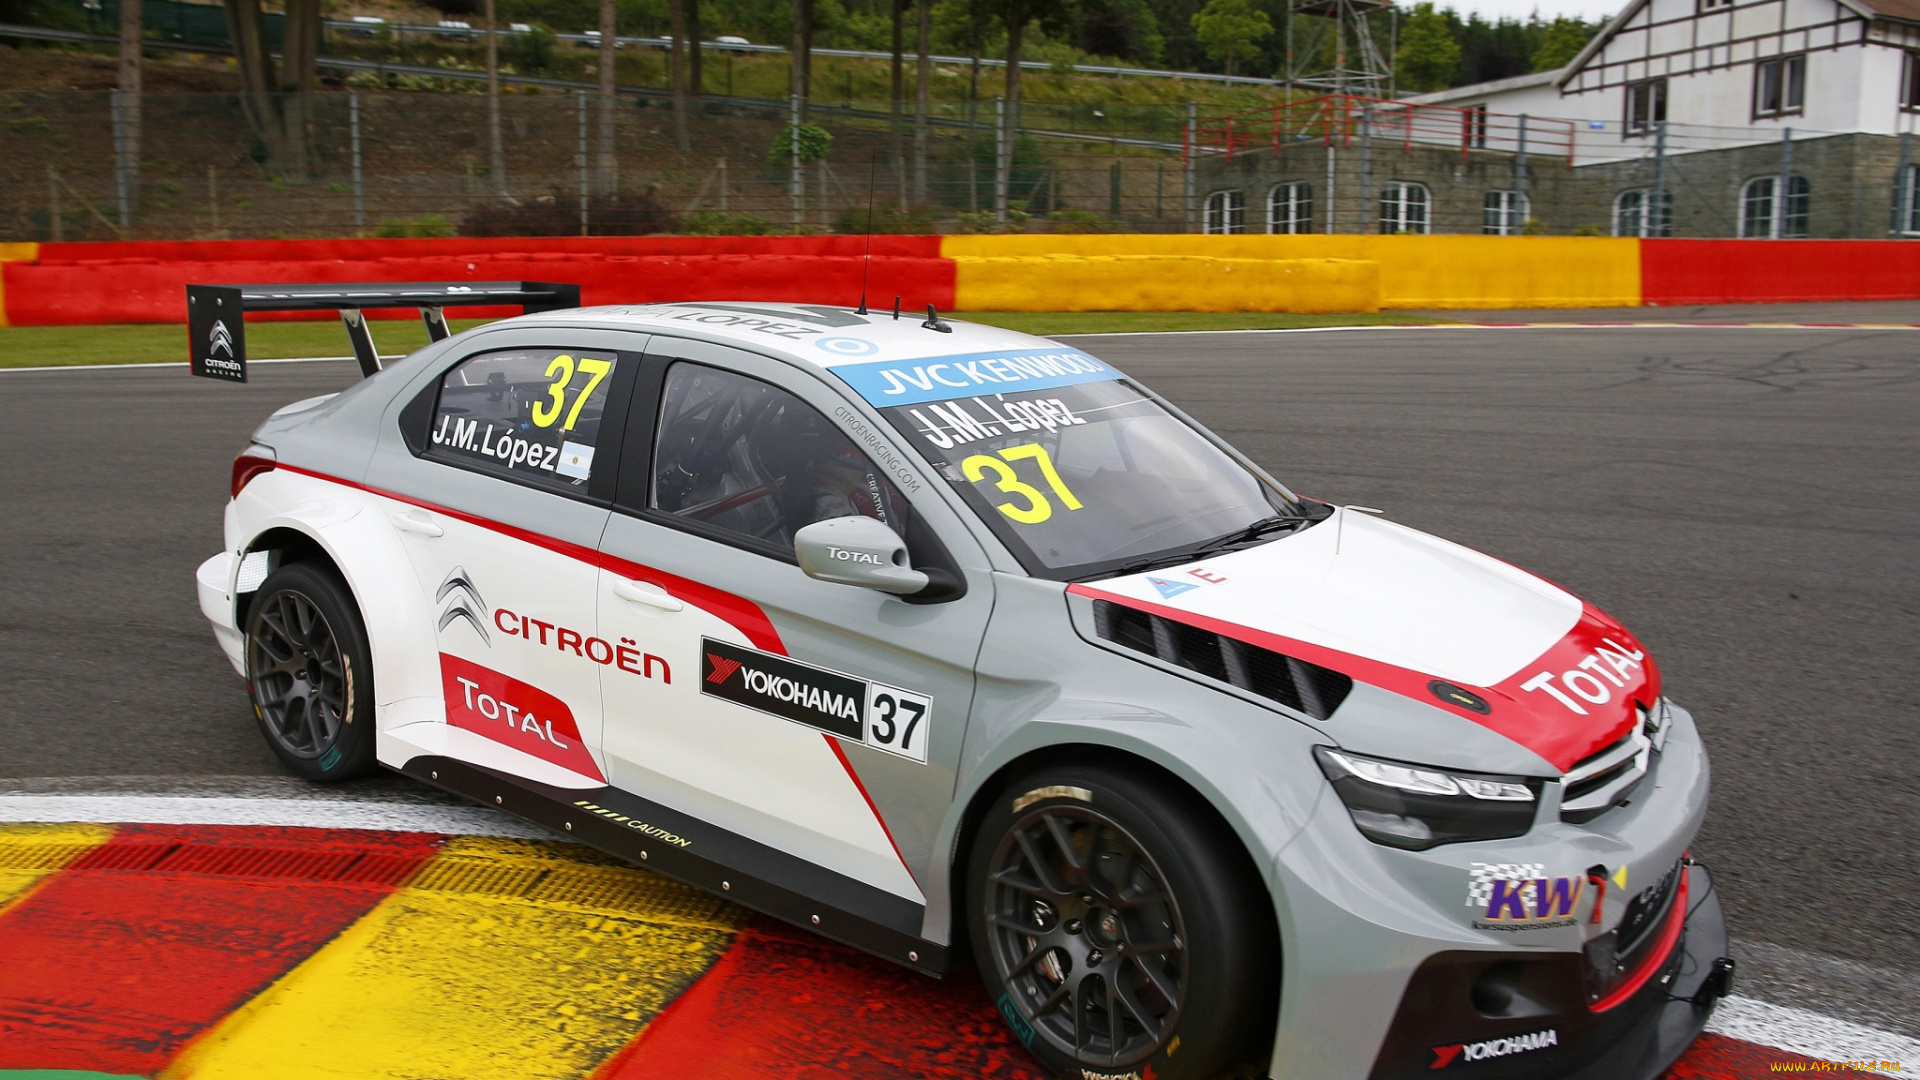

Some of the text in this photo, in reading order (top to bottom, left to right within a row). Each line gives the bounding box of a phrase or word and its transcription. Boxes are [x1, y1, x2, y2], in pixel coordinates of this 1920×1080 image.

[532, 354, 612, 431] 37
[834, 406, 921, 494] CITROENRACING.COM
[961, 443, 1084, 524] 37
[826, 546, 883, 565] TOTAL
[1187, 568, 1228, 584] E
[741, 666, 859, 723] YOKOHAMA
[1519, 637, 1644, 715] TOTAL
[456, 675, 569, 750] TOTAL
[871, 693, 926, 750] 37
[627, 820, 692, 847] CAUTION
[1484, 875, 1586, 922] KW
[1462, 1028, 1558, 1062] YOKOHAMA
